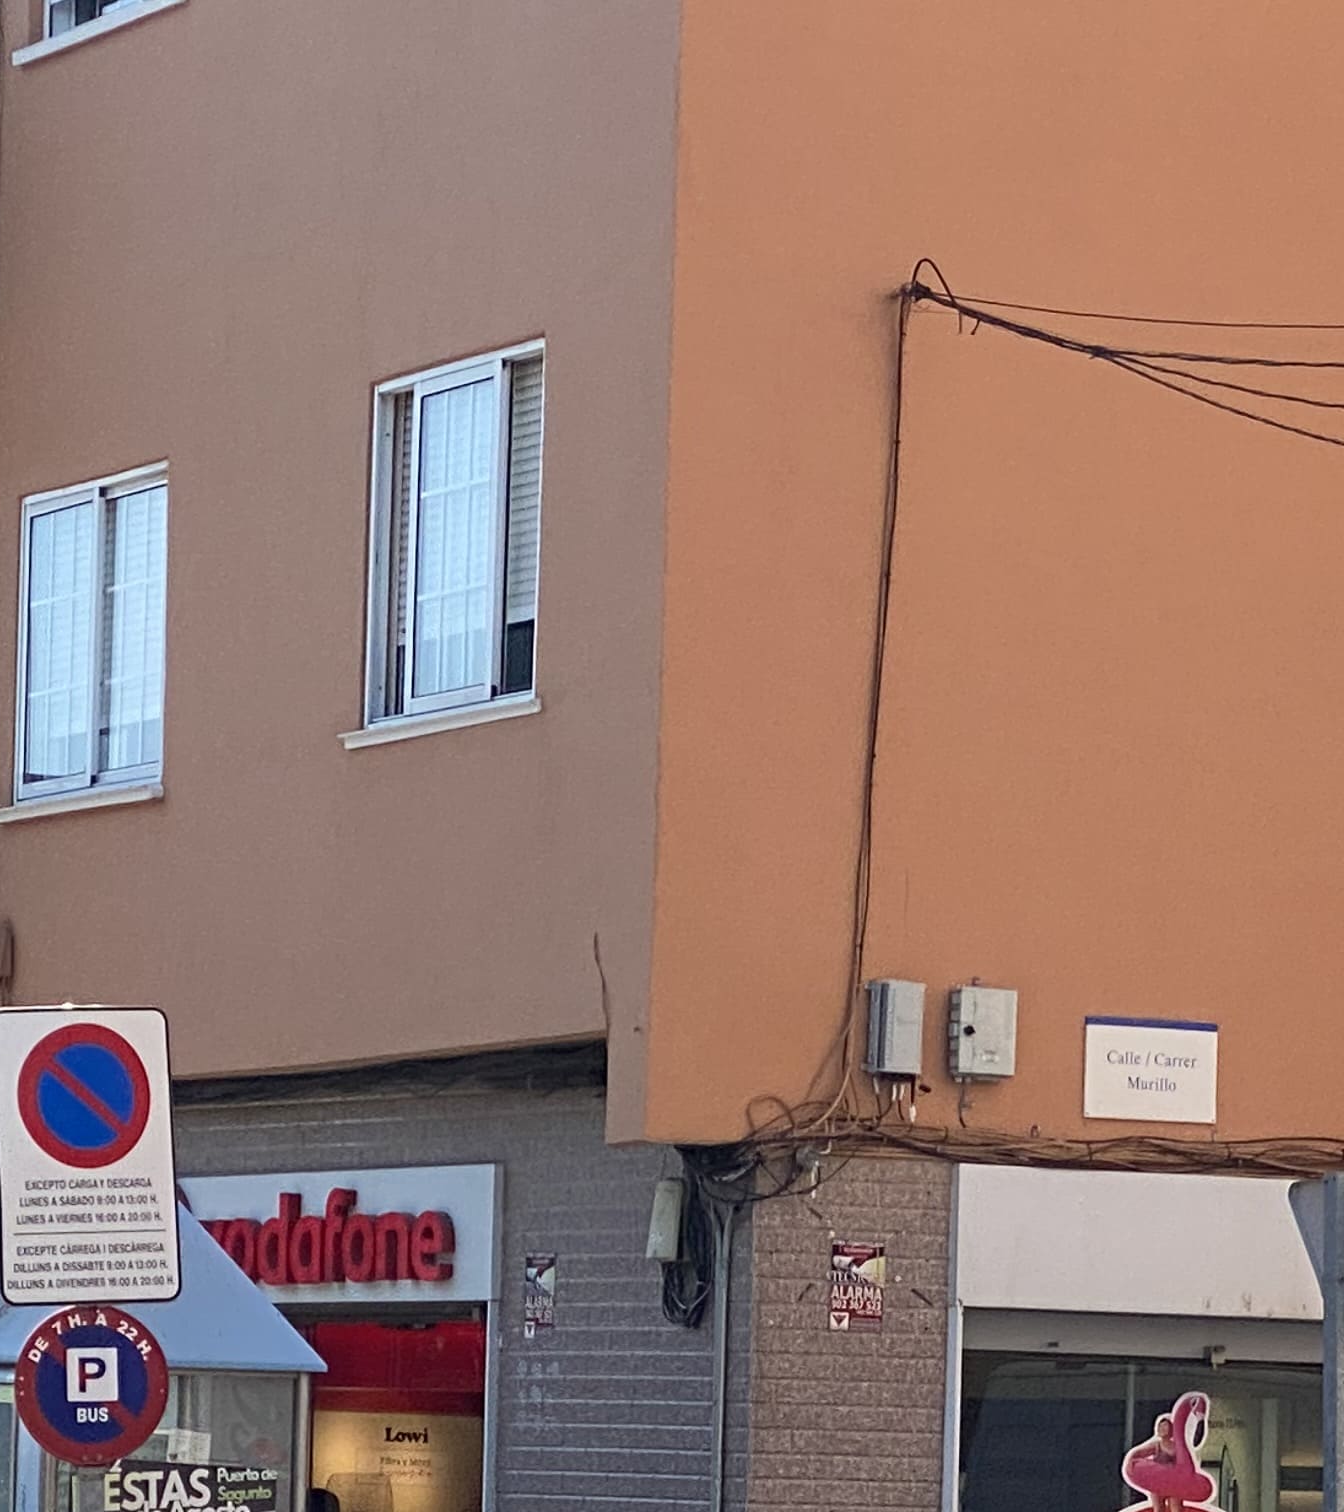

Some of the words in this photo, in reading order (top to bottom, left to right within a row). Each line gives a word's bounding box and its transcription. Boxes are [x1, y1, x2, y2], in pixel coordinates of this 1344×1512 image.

[1106, 1049, 1141, 1065] Calle
[1154, 1052, 1198, 1069] Carrer
[1127, 1076, 1177, 1092] Murillo
[25, 1179, 66, 1191] EXCEPTO
[68, 1179, 98, 1190] CARGA
[99, 1179, 104, 1188] Y
[107, 1178, 152, 1188] DESCARGA
[19, 1197, 49, 1207] LUNES
[50, 1196, 57, 1206] A
[118, 1195, 124, 1204] A
[16, 1215, 45, 1225] LUNES
[48, 1214, 54, 1224] A
[56, 1213, 93, 1223] VIERNES
[120, 1212, 126, 1221] A
[199, 1187, 455, 1284] odafone
[17, 1245, 57, 1256] EXCEPTE
[13, 1262, 52, 1273] DILLUNS
[54, 1261, 59, 1272] A
[62, 1260, 104, 1272] DISSABTE
[128, 1260, 134, 1269] A
[7, 1279, 45, 1290] DILLUNS
[47, 1278, 53, 1289] A
[56, 1277, 106, 1289] DIVENDRES
[132, 1277, 138, 1287] A
[831, 1284, 882, 1301] ALARMA
[27, 1336, 49, 1364] DE
[51, 1321, 63, 1335] 7
[116, 1320, 139, 1340] 22
[78, 1357, 107, 1393] P
[76, 1407, 109, 1423] BUS
[384, 1427, 429, 1444] Lowi
[217, 1467, 259, 1483] Puerto
[217, 1486, 272, 1505] Sagunto
